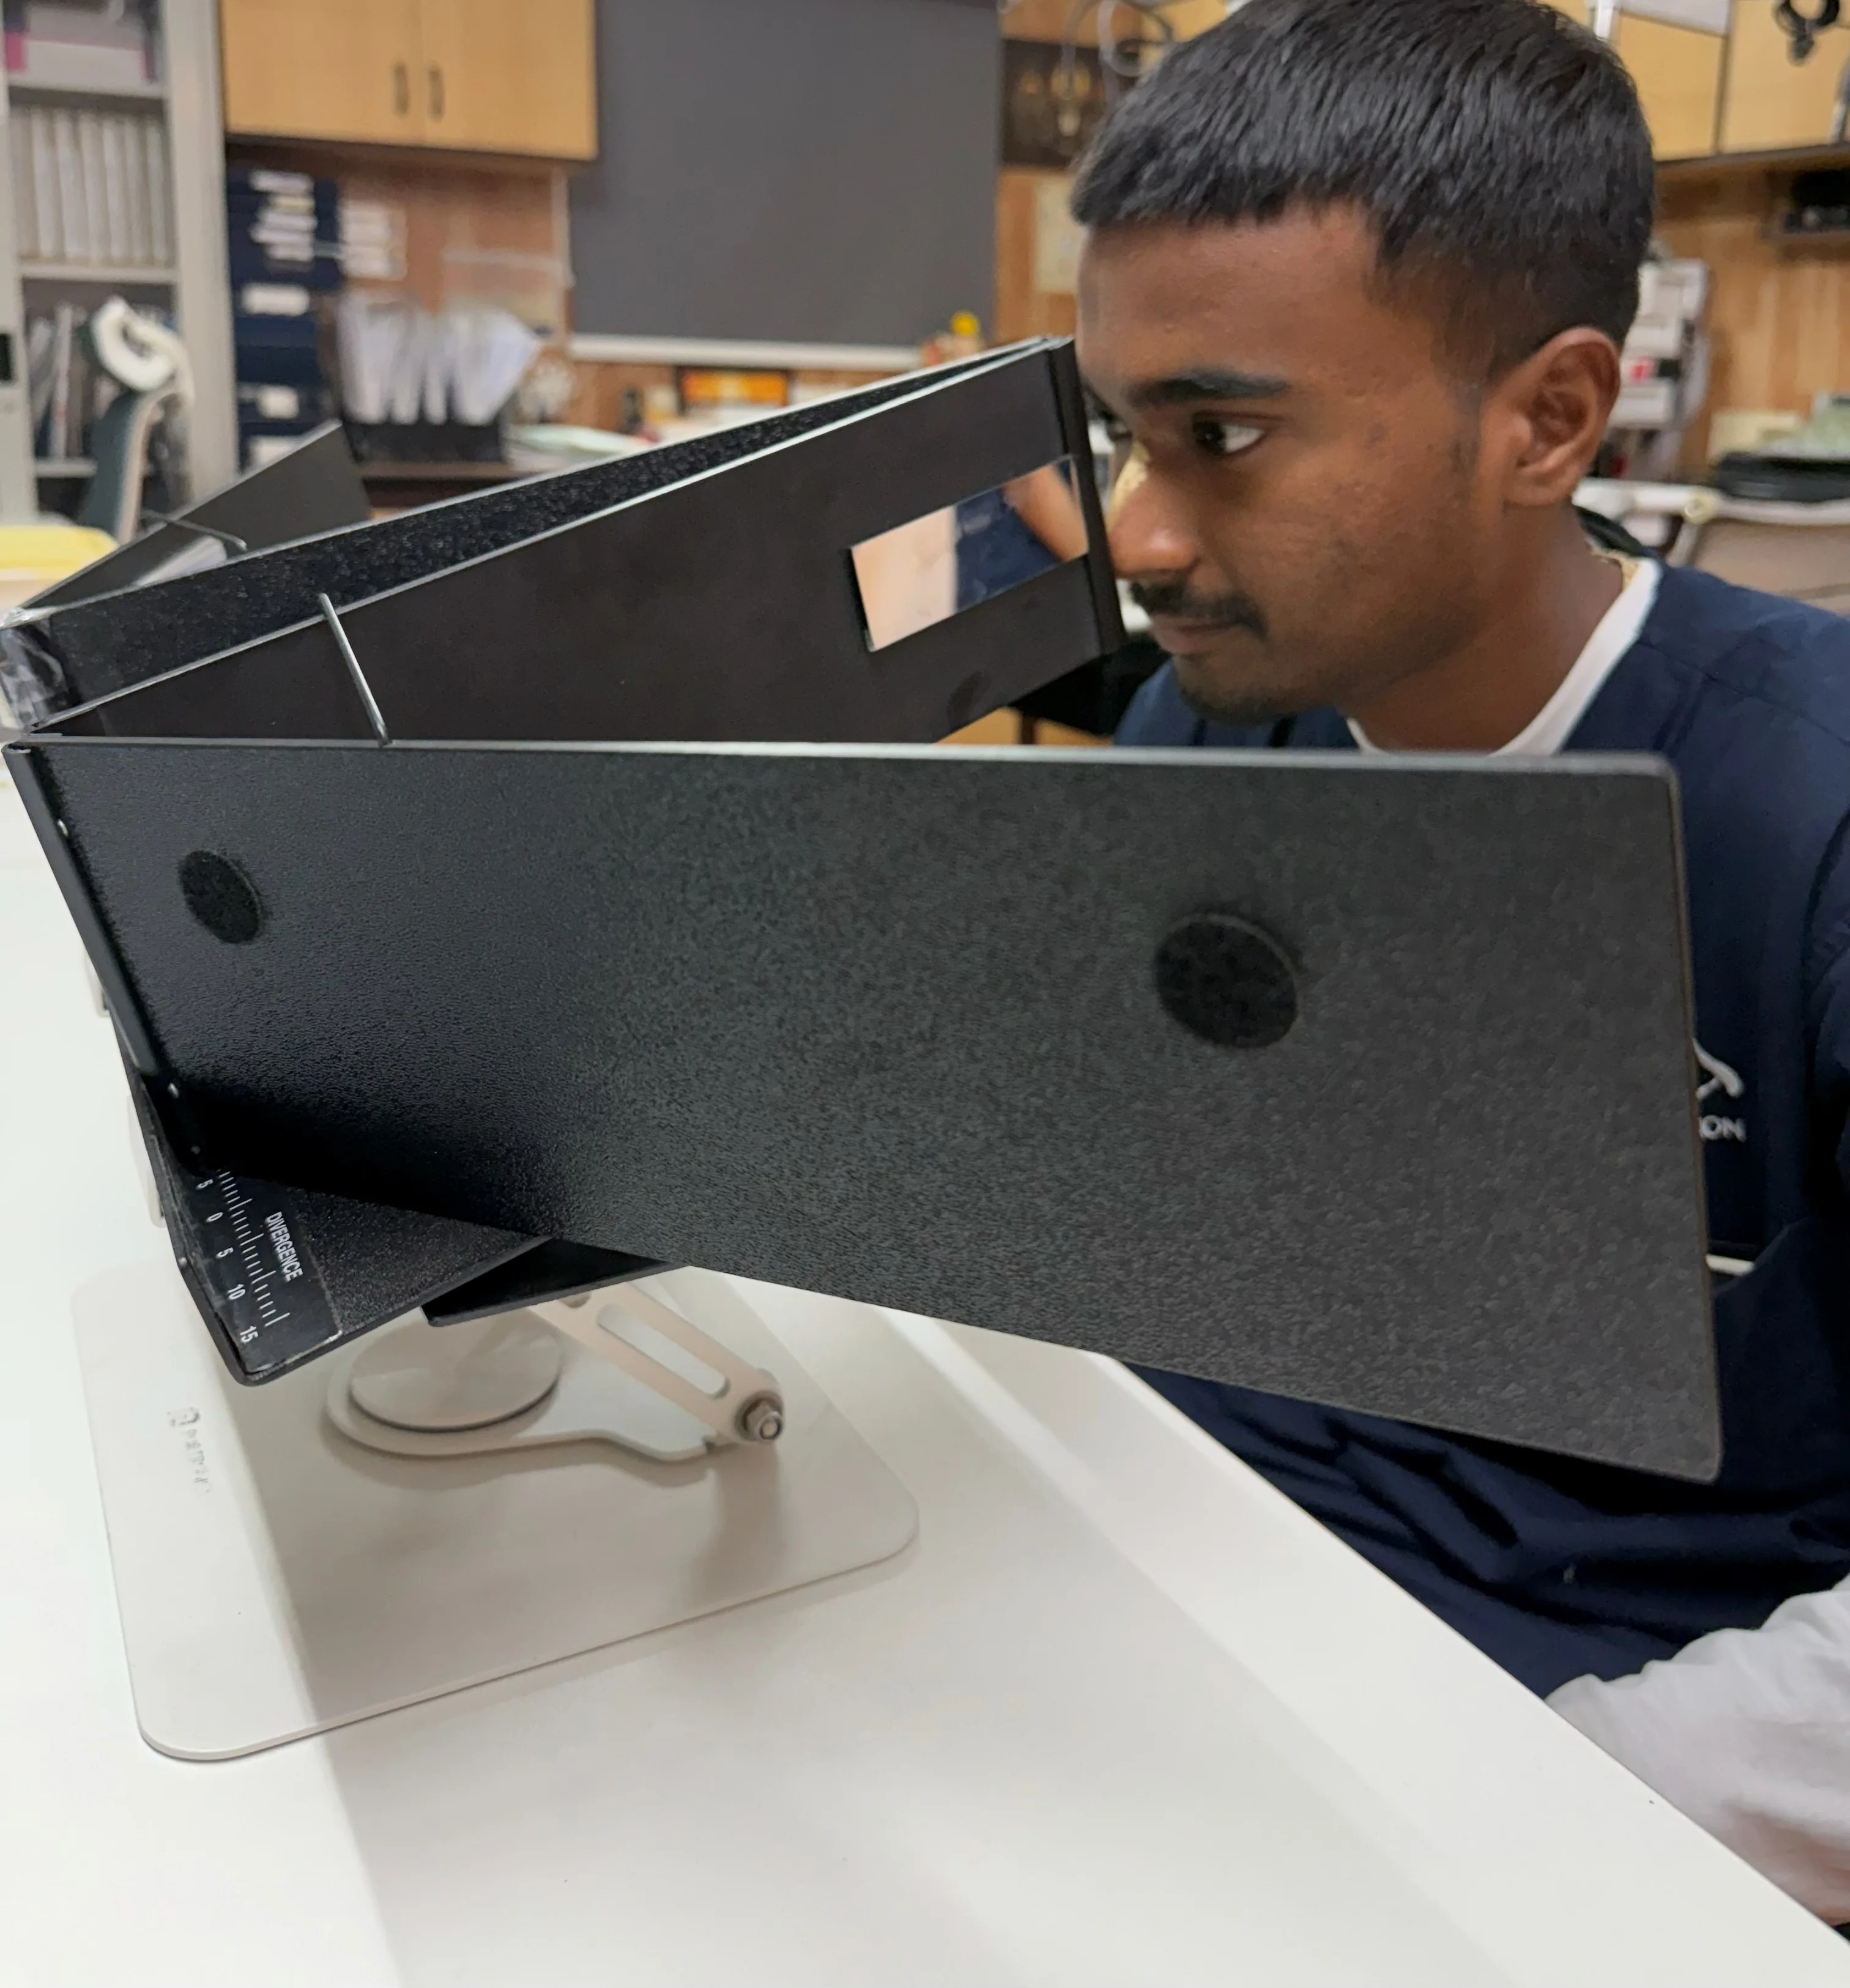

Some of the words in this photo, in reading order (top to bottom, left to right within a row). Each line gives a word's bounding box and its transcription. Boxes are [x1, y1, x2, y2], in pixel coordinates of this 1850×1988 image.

[206, 1212, 223, 1223] 0
[216, 1247, 234, 1258] 5
[226, 1284, 246, 1300] 10
[240, 1326, 259, 1343] 15
[265, 1211, 303, 1282] DIVERGENCE
